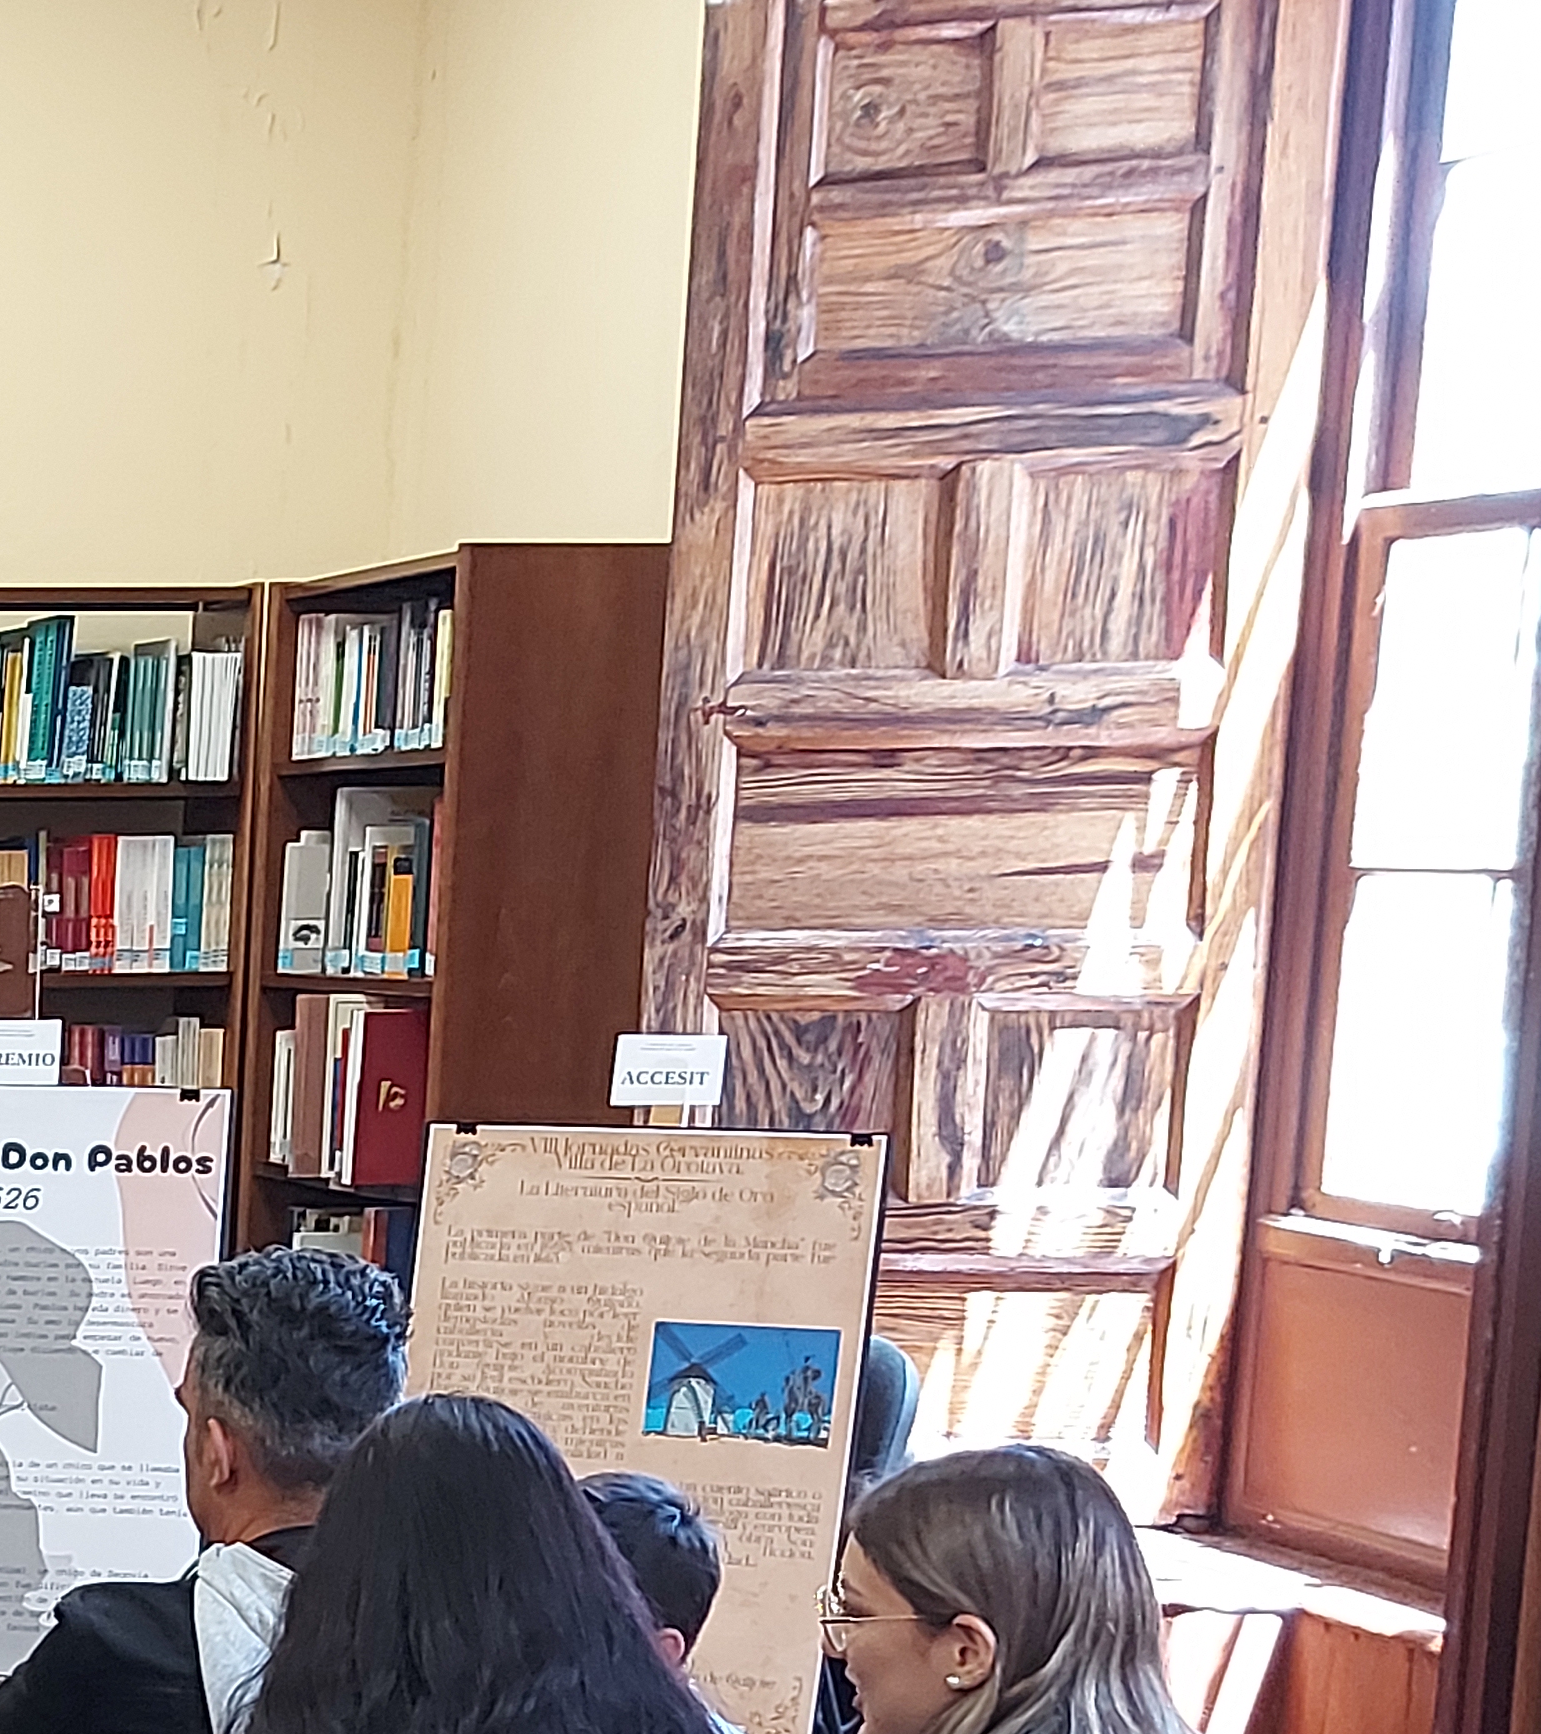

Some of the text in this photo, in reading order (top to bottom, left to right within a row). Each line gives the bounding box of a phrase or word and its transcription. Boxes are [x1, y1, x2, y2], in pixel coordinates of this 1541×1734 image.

[620, 1070, 709, 1085] ACCESIT
[1, 1141, 72, 1173] Don
[87, 1144, 214, 1176] Pablos
